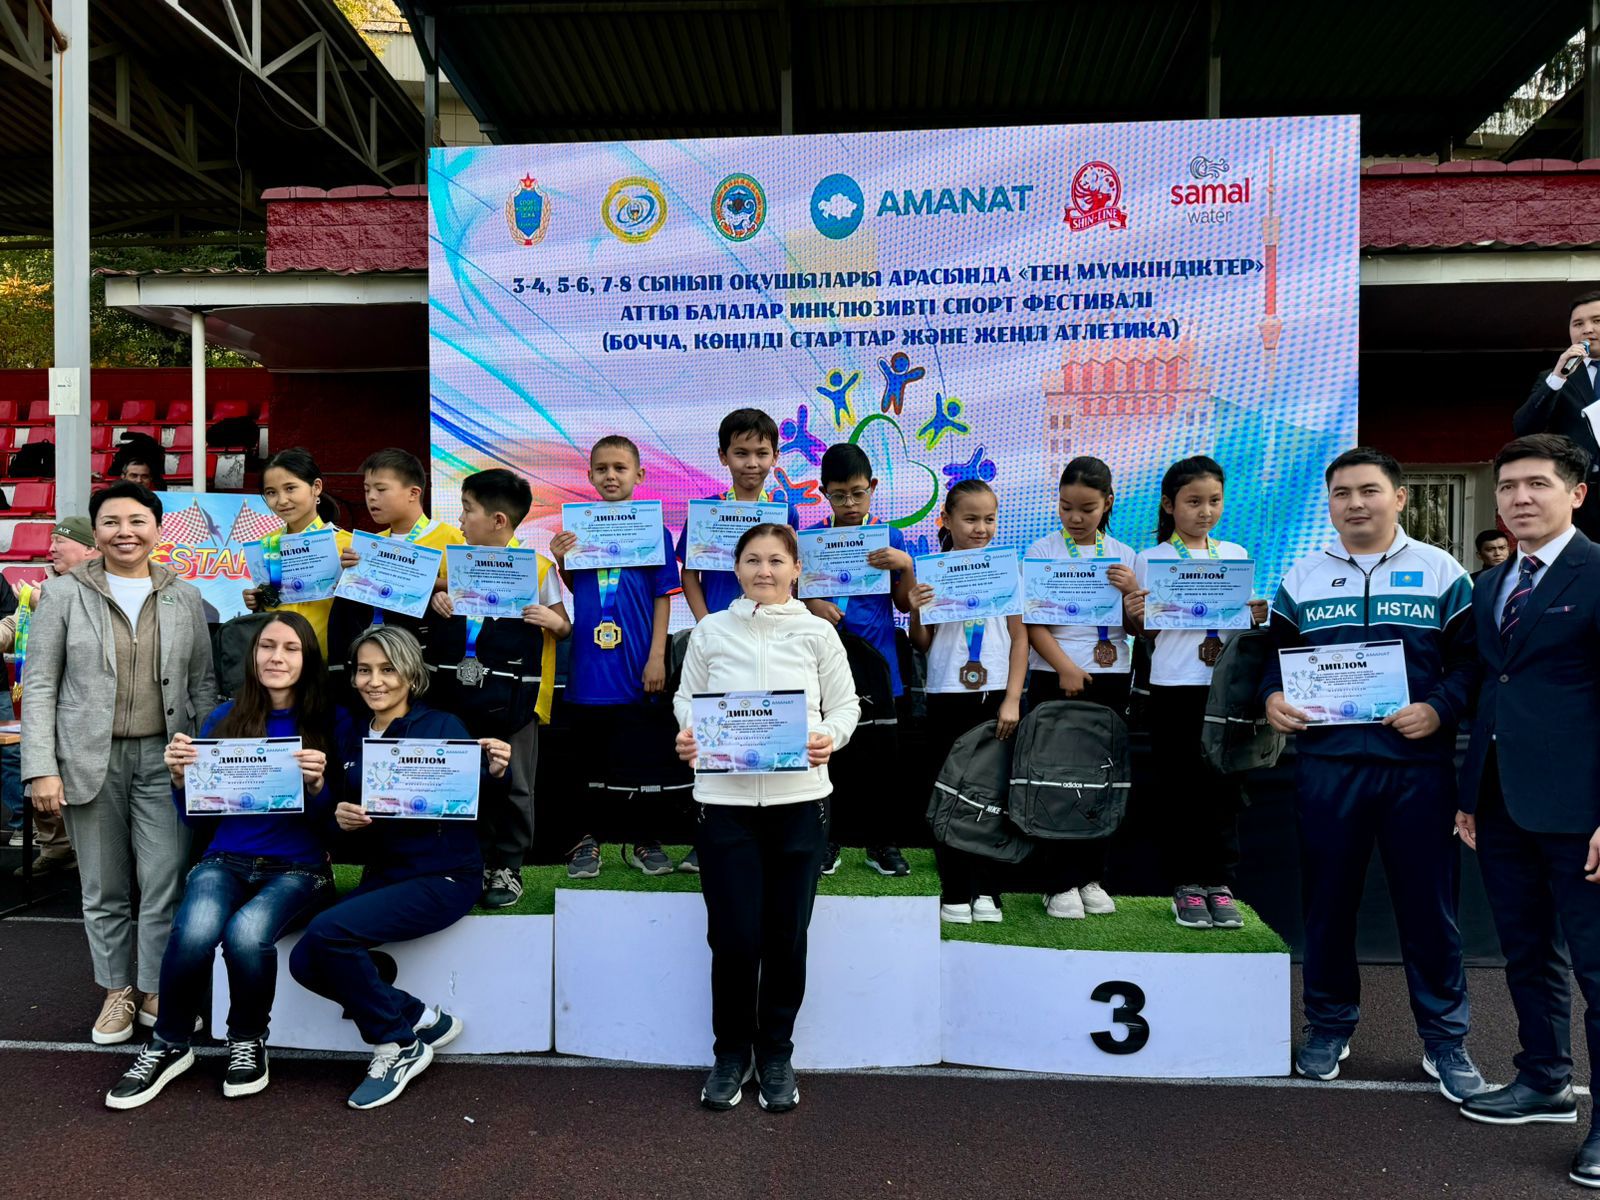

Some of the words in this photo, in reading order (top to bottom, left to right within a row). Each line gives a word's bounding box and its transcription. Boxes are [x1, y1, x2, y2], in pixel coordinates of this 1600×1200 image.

[1170, 177, 1250, 206] samal
[877, 184, 1034, 217] AMANAT
[1072, 207, 1119, 230] SHIN-LINE
[1187, 207, 1232, 224] water
[512, 277, 551, 297] 3-4,
[558, 276, 595, 296] 5-6,
[601, 275, 632, 293] 7-8
[638, 274, 723, 293] СЫНЫП
[729, 269, 882, 292] ОҚУШЫЛАРЫ
[889, 266, 1012, 287] АРАСЫНДА
[1018, 264, 1071, 285] «ТЕҢ
[1077, 258, 1265, 281] МҮМКІНДІКТЕР»
[620, 304, 679, 321] АТТЫ
[686, 303, 784, 321] БАЛАЛАР
[790, 299, 936, 319] ИНКЛЮЗИВТІ
[942, 296, 1017, 315] СПОРТ
[1023, 291, 1153, 312] ФЕСТИВАЛІ
[602, 330, 688, 353] (БОЧЧА,
[695, 332, 783, 353] КӨҢІЛДІ
[791, 329, 896, 349] СТАРТТАР
[902, 326, 968, 346] ЖӘНЕ
[974, 324, 1048, 346] ЖЕҢІЛ
[1055, 317, 1180, 343] АТЛЕТИКА)
[594, 514, 636, 523] ДИПЛОМ
[719, 514, 761, 523] ДИПЛОМ
[825, 540, 864, 550] ДИПЛОМ
[280, 546, 310, 557] ПЛОМ
[377, 550, 416, 565] ДИПЛОМ
[475, 559, 513, 569] ДИПЛОМ
[947, 562, 990, 573] ДИПЛОМ
[1053, 571, 1096, 579] ДИПЛОМ
[1178, 572, 1225, 580] ДИПЛОМ
[1305, 603, 1358, 623] KAZAK
[1377, 601, 1435, 620] HSTAN
[1317, 661, 1367, 672] ДИПЛОМ
[725, 709, 773, 719] ДИПЛОМ
[219, 756, 267, 765] ДИПЛОМ
[398, 757, 446, 765] ДИПЛОМ
[1089, 980, 1150, 1055] 3
